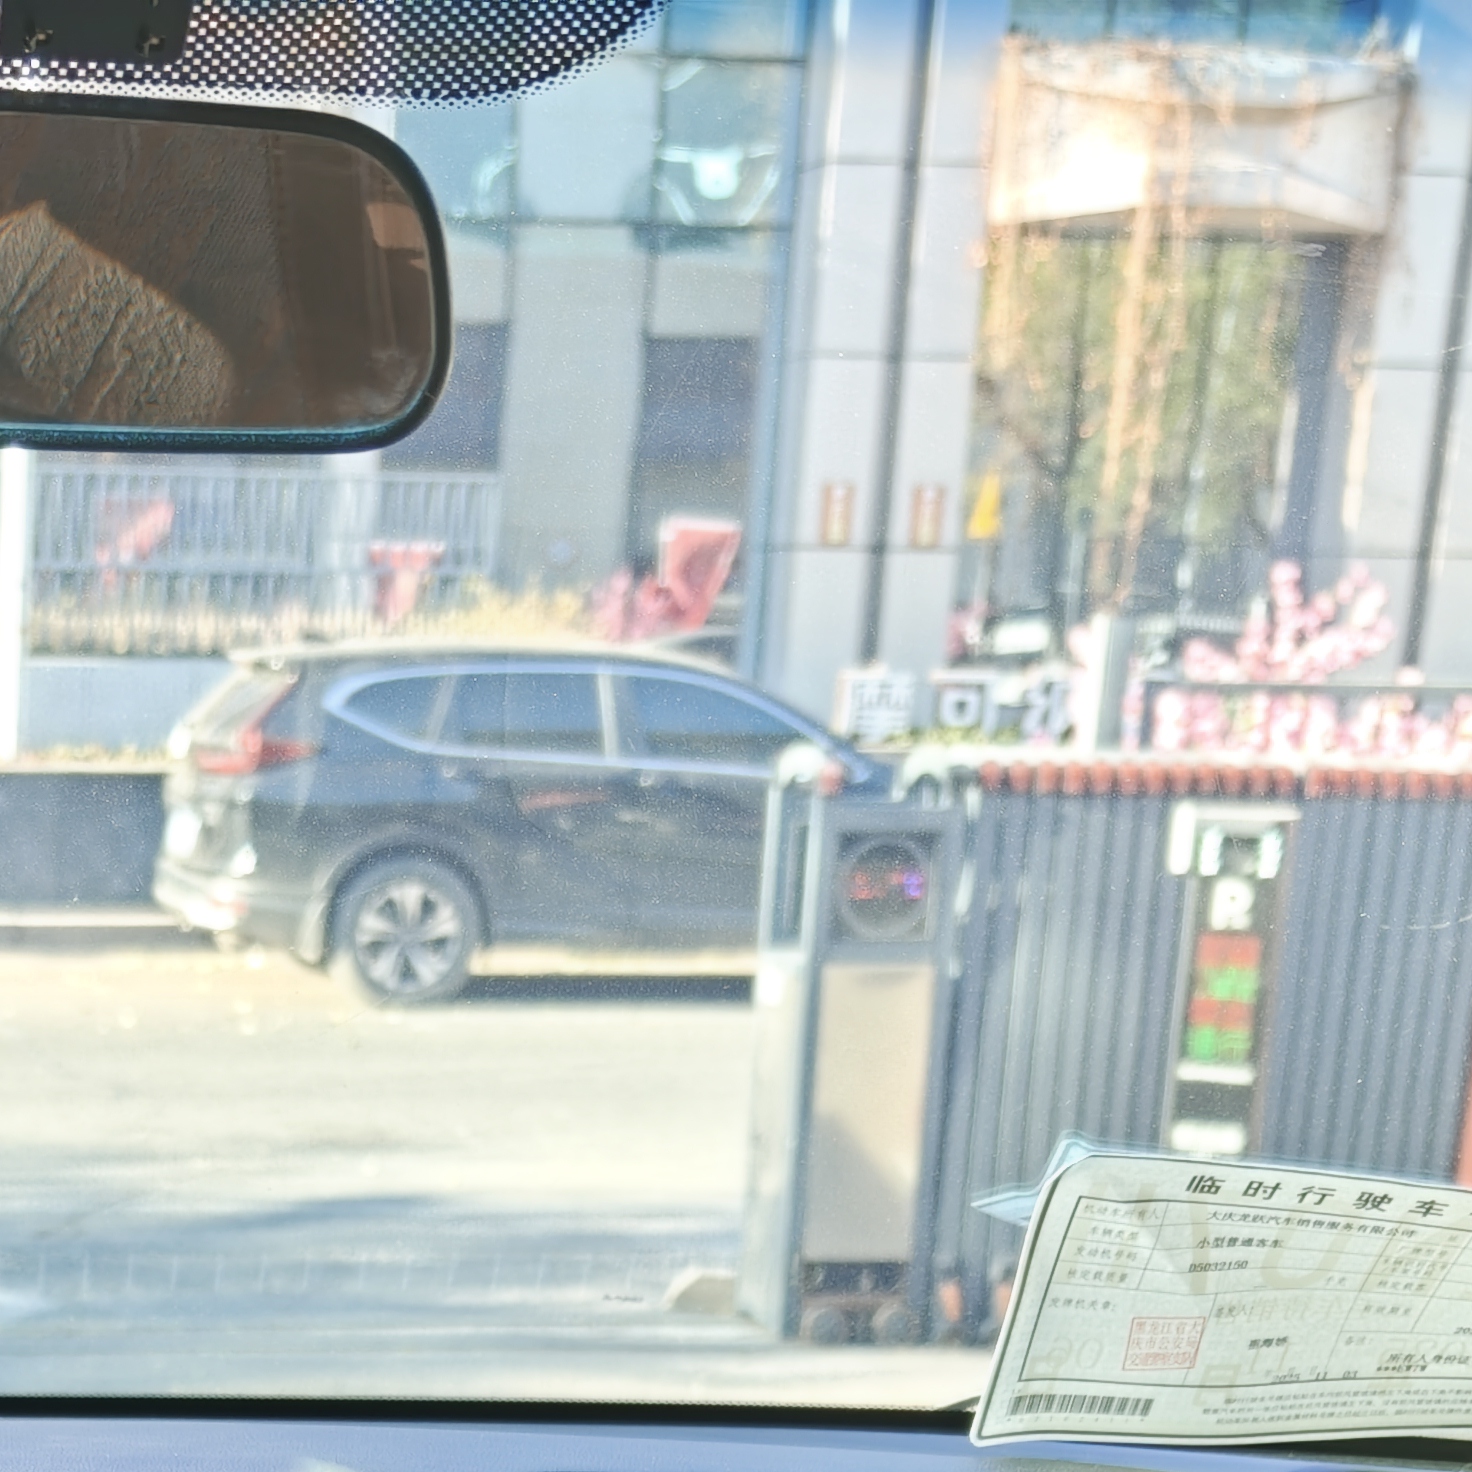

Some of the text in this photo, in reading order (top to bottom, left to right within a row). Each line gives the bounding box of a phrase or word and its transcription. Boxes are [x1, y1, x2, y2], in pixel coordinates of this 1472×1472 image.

[1196, 1236, 1285, 1249] 小型普通客车
